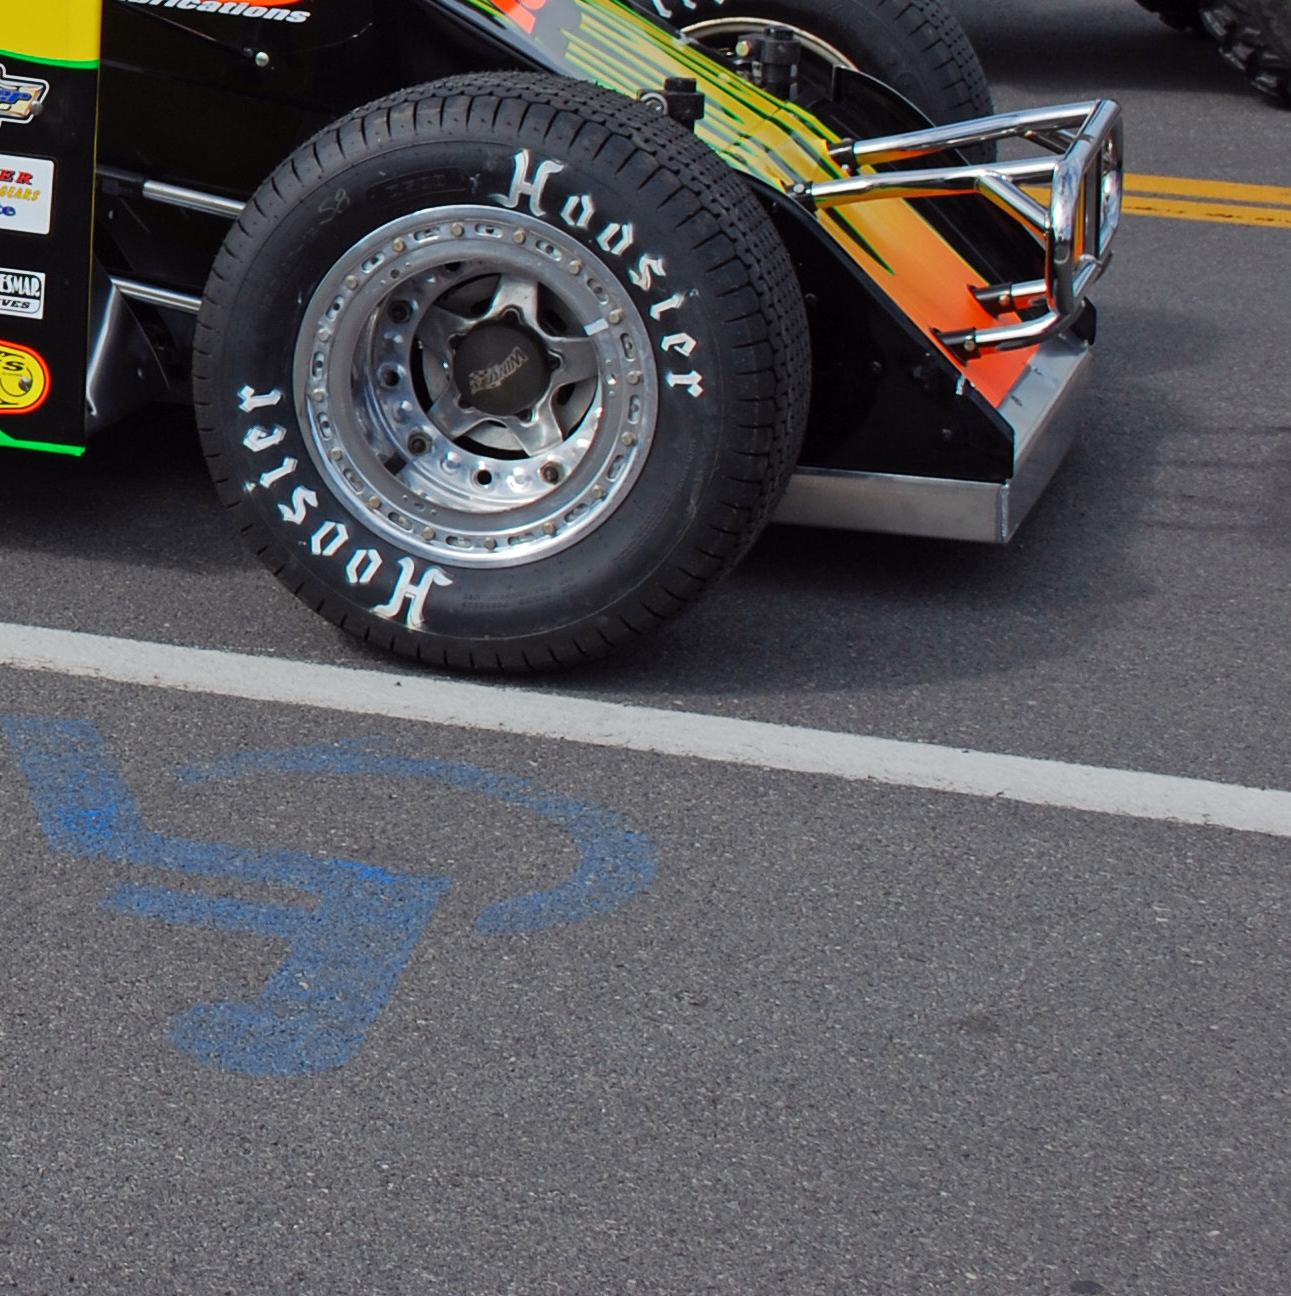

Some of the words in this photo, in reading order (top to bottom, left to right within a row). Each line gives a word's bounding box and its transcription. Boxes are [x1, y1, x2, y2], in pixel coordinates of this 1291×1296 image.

[0, 185, 41, 202] GEARS
[494, 147, 705, 400] Hoosier
[236, 384, 454, 631] Hoosier
